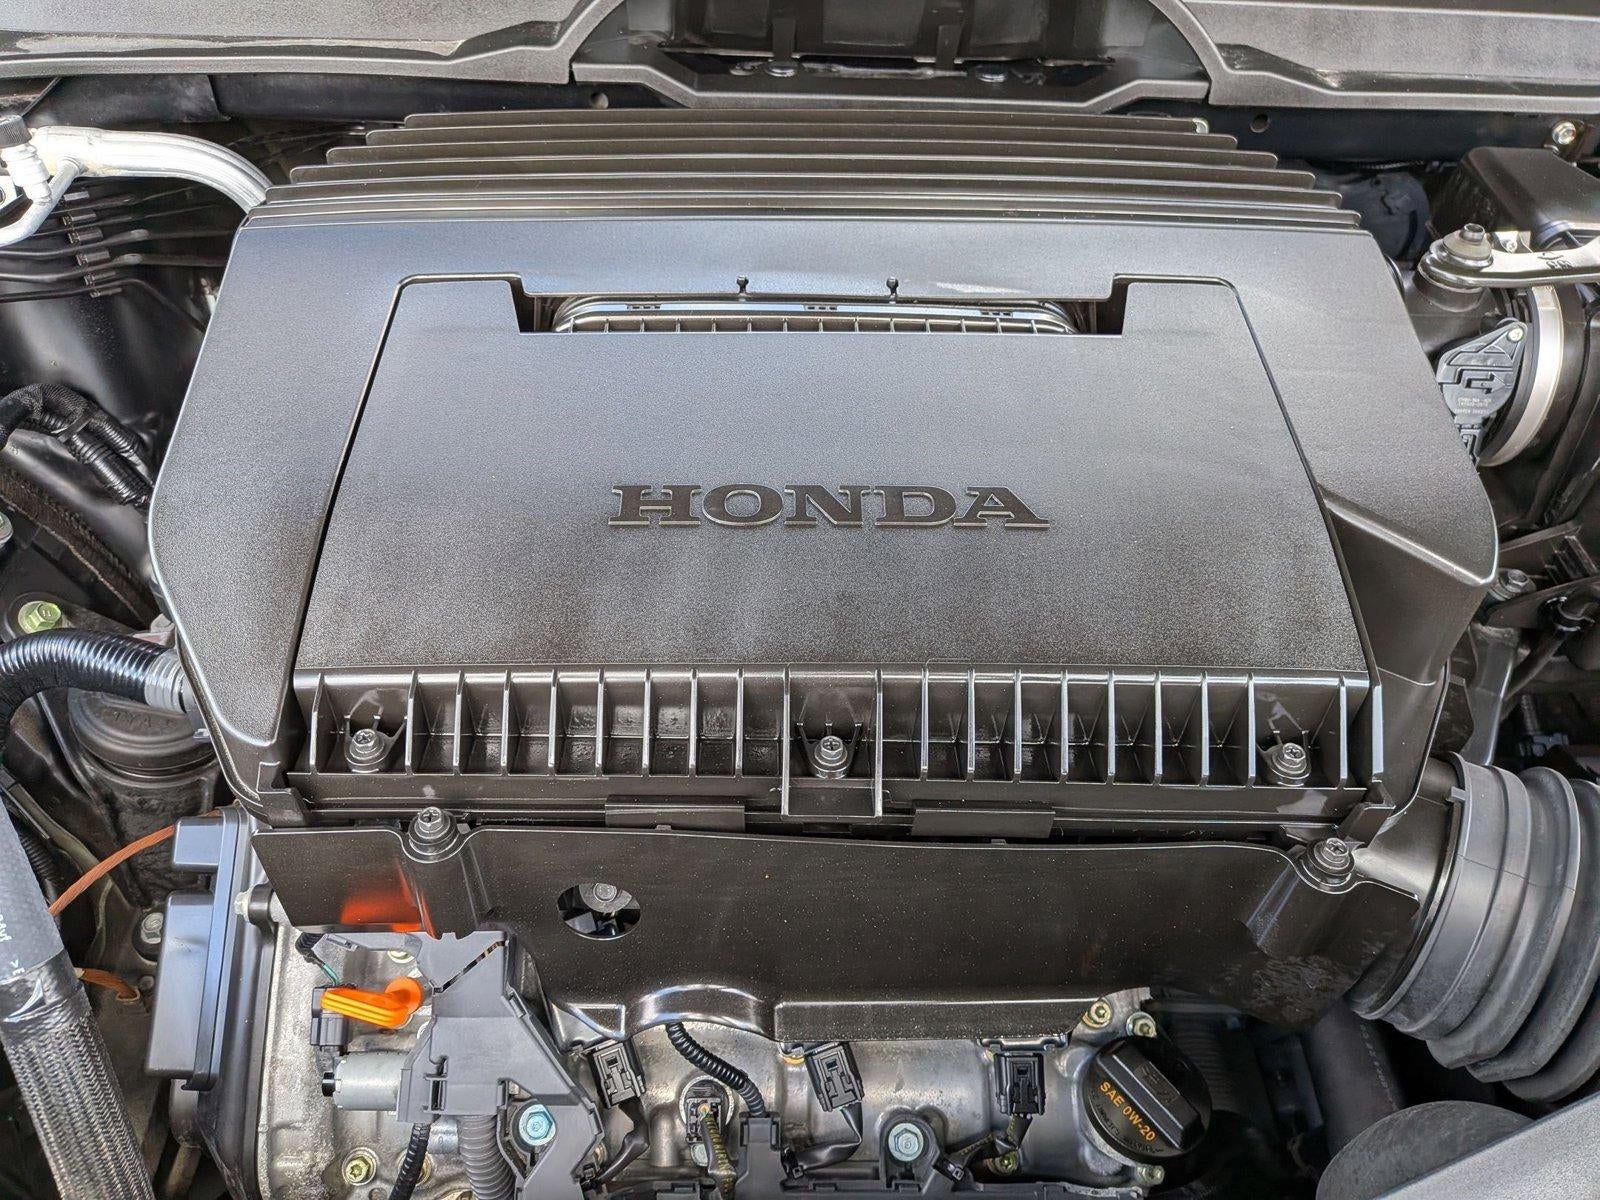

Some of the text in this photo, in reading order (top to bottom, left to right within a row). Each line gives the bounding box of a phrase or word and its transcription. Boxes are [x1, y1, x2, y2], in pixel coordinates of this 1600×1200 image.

[608, 484, 1050, 528] HONDA
[1100, 1081, 1124, 1107] SAE
[1122, 1105, 1156, 1141] 0W-20
